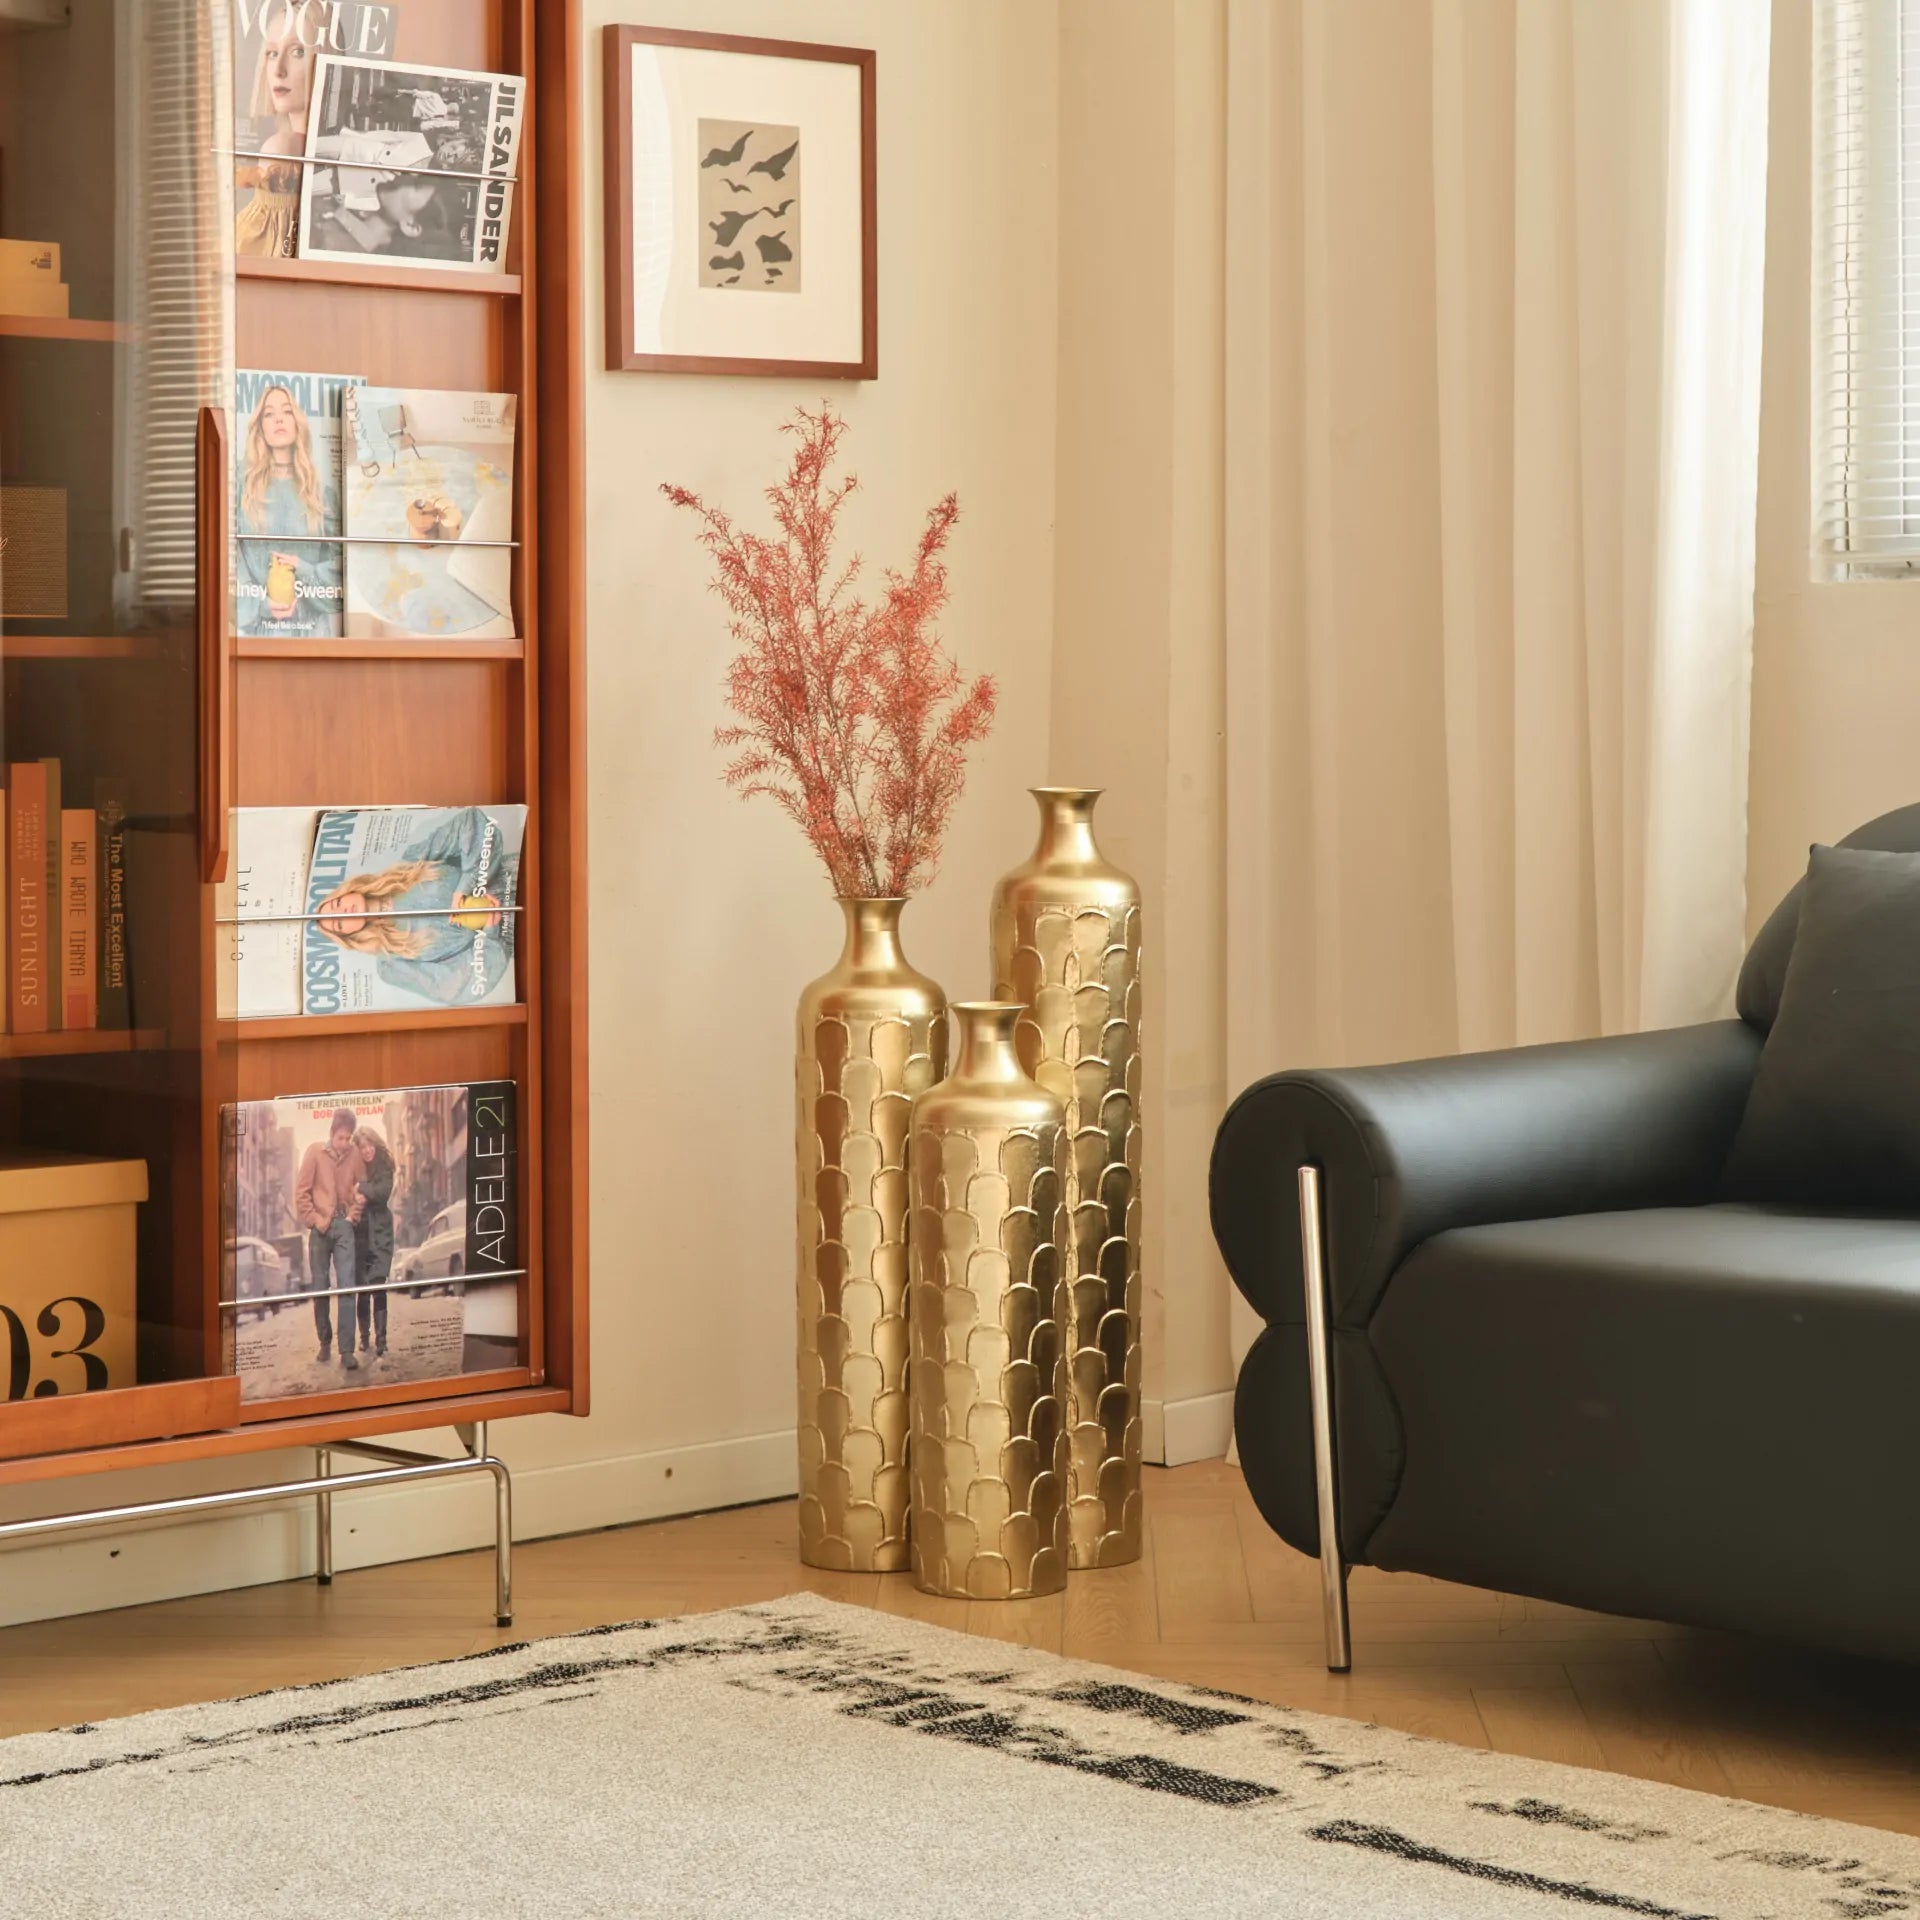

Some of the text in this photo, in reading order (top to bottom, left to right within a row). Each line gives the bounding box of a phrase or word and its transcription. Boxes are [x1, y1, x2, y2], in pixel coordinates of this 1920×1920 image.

[238, 0, 389, 55] VOGUE
[480, 82, 517, 263] JIL SANDER
[237, 580, 343, 601] ney Sween
[69, 876, 87, 920] WROTE
[70, 841, 87, 866] WHO
[20, 877, 38, 1006] SUNLIGHT
[110, 833, 124, 988] The Most Excellent
[306, 812, 358, 1014] COSMOLITAN
[471, 816, 498, 996] Sydney Sweeney
[296, 1095, 385, 1110] THE FREEWHEELIN'
[313, 1105, 384, 1120] BOB DYLAN
[475, 1096, 505, 1264] ADELE 21
